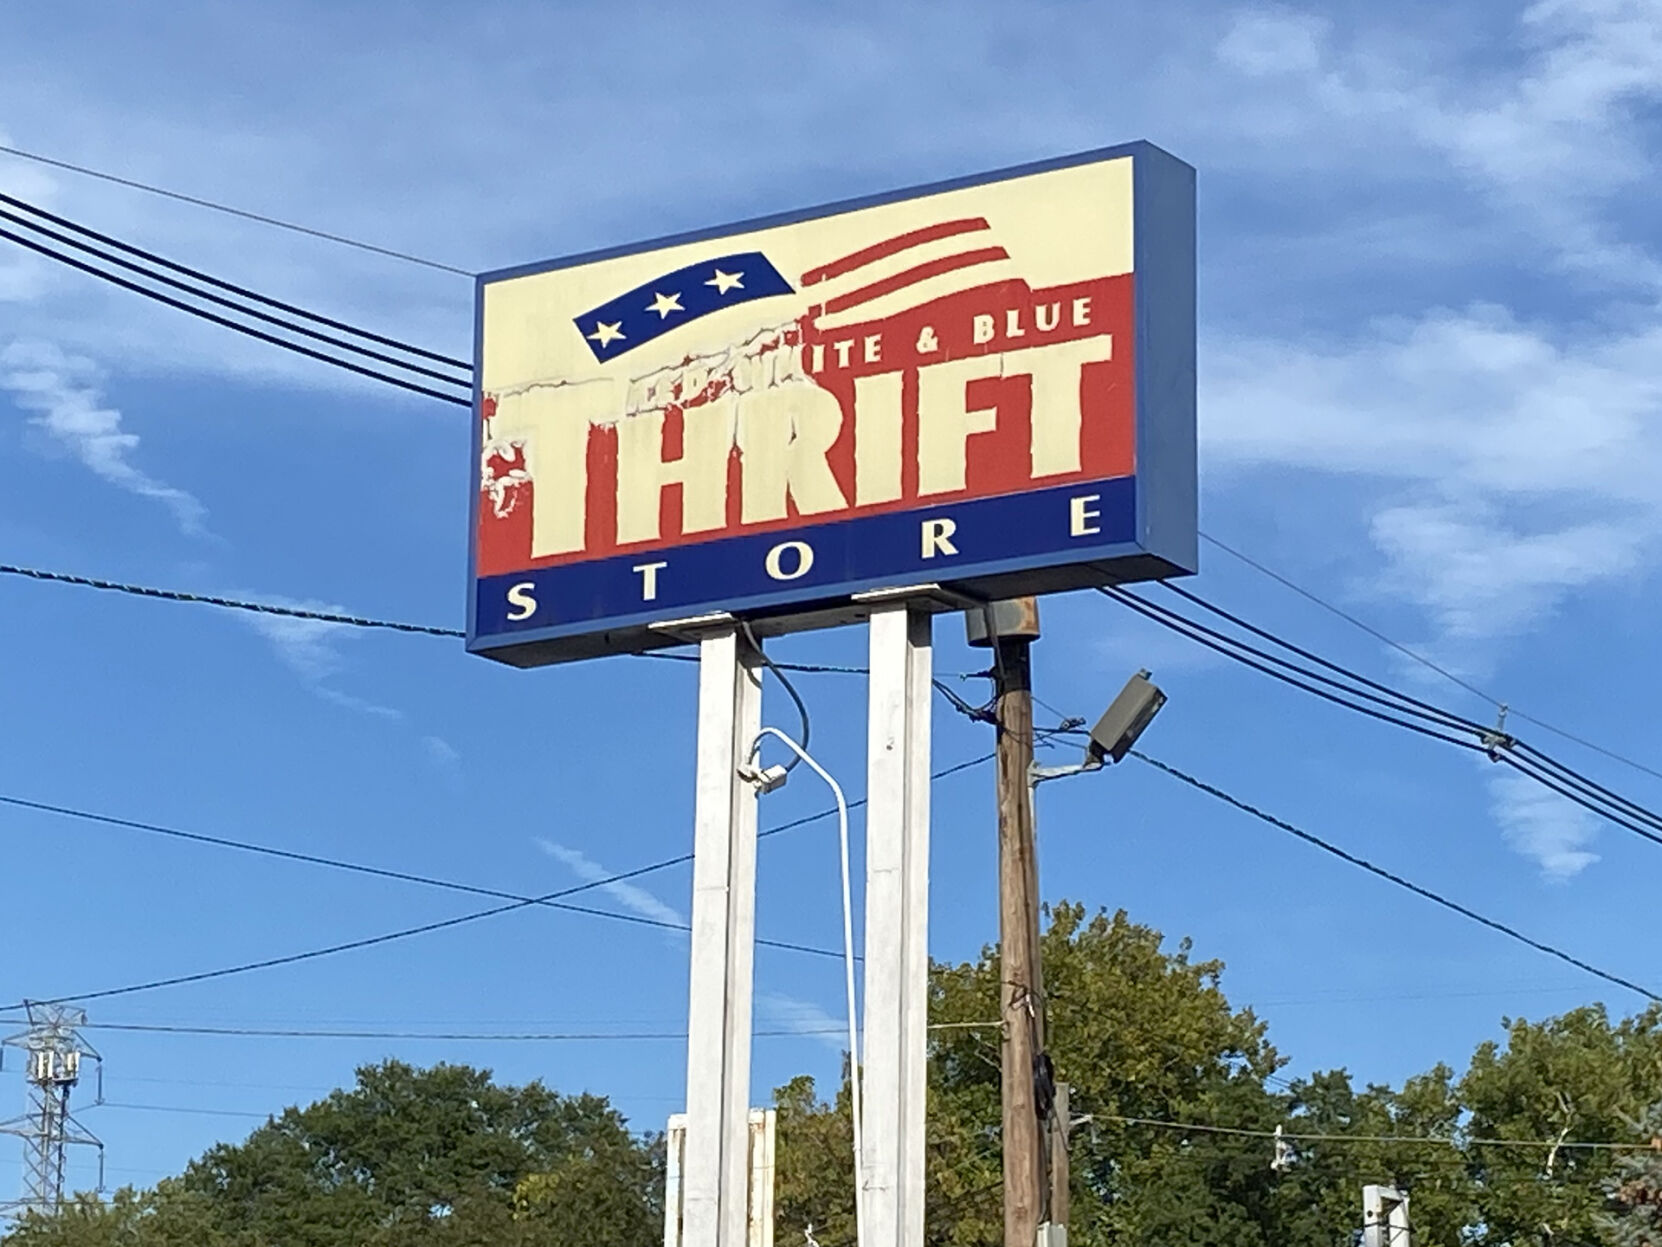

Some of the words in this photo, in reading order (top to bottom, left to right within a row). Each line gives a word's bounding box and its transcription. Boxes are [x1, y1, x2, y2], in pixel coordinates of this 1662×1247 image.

[916, 326, 938, 354] &
[973, 297, 1092, 344] BLUE
[493, 334, 1113, 560] THRIFT
[506, 494, 1100, 620] STORE
